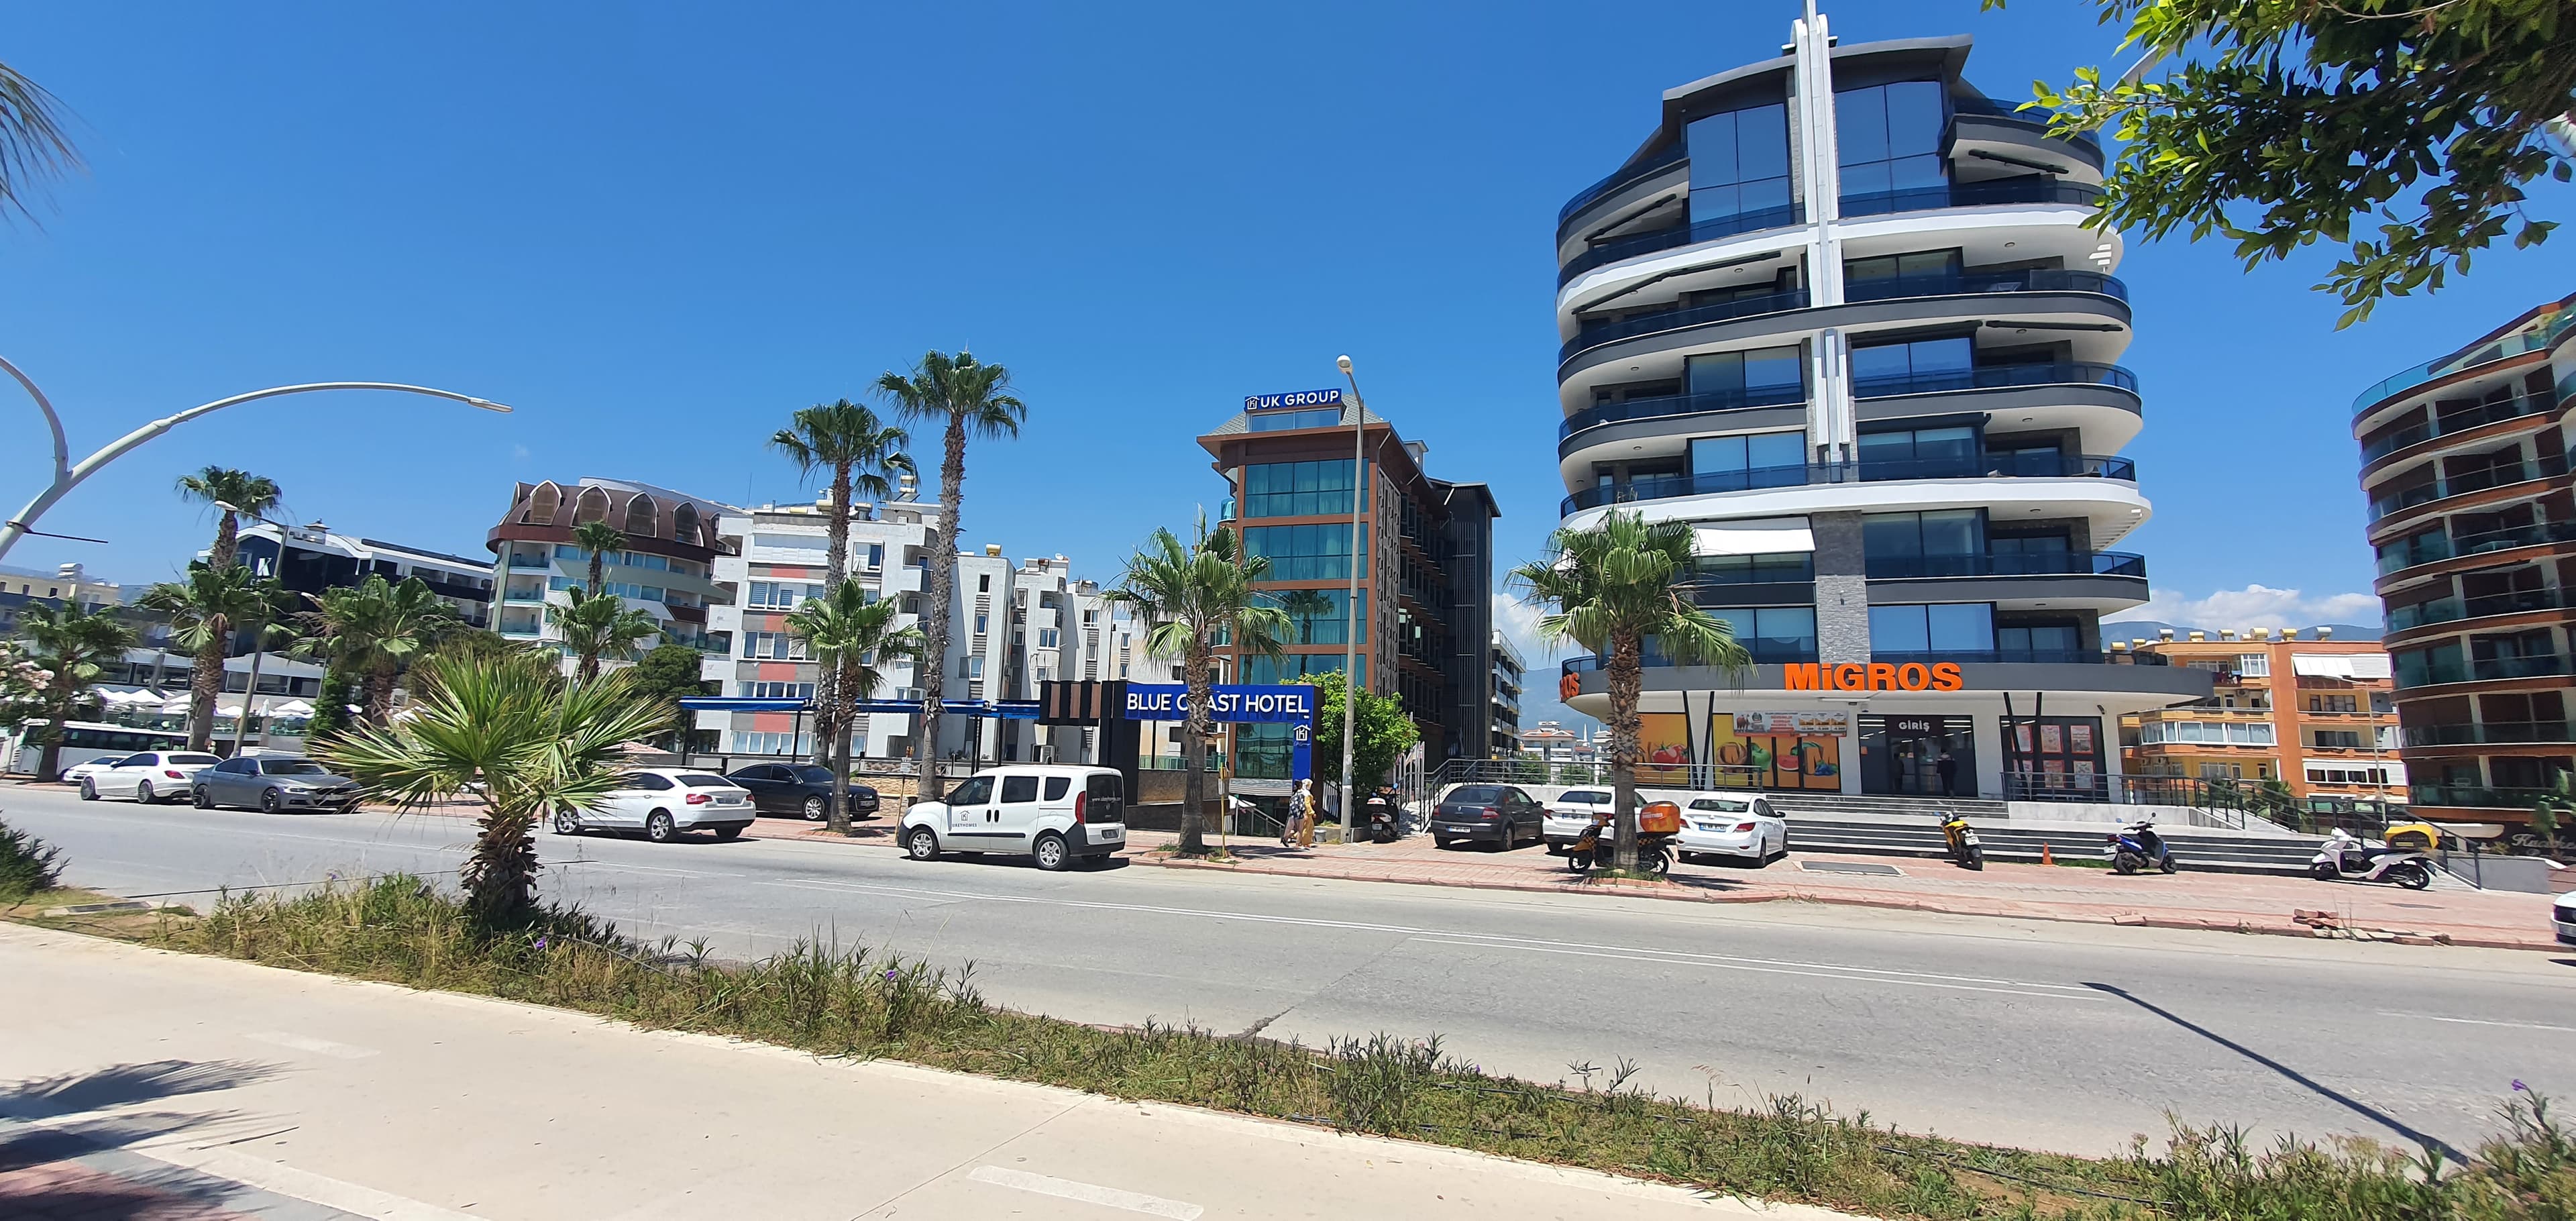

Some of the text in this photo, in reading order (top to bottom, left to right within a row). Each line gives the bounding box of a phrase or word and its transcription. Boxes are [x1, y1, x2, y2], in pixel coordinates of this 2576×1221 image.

[1261, 390, 1338, 408] UK GROUP
[1127, 693, 1309, 713] BLUE CAST HOTEL
[1898, 720, 1930, 732] GİRİŞ
